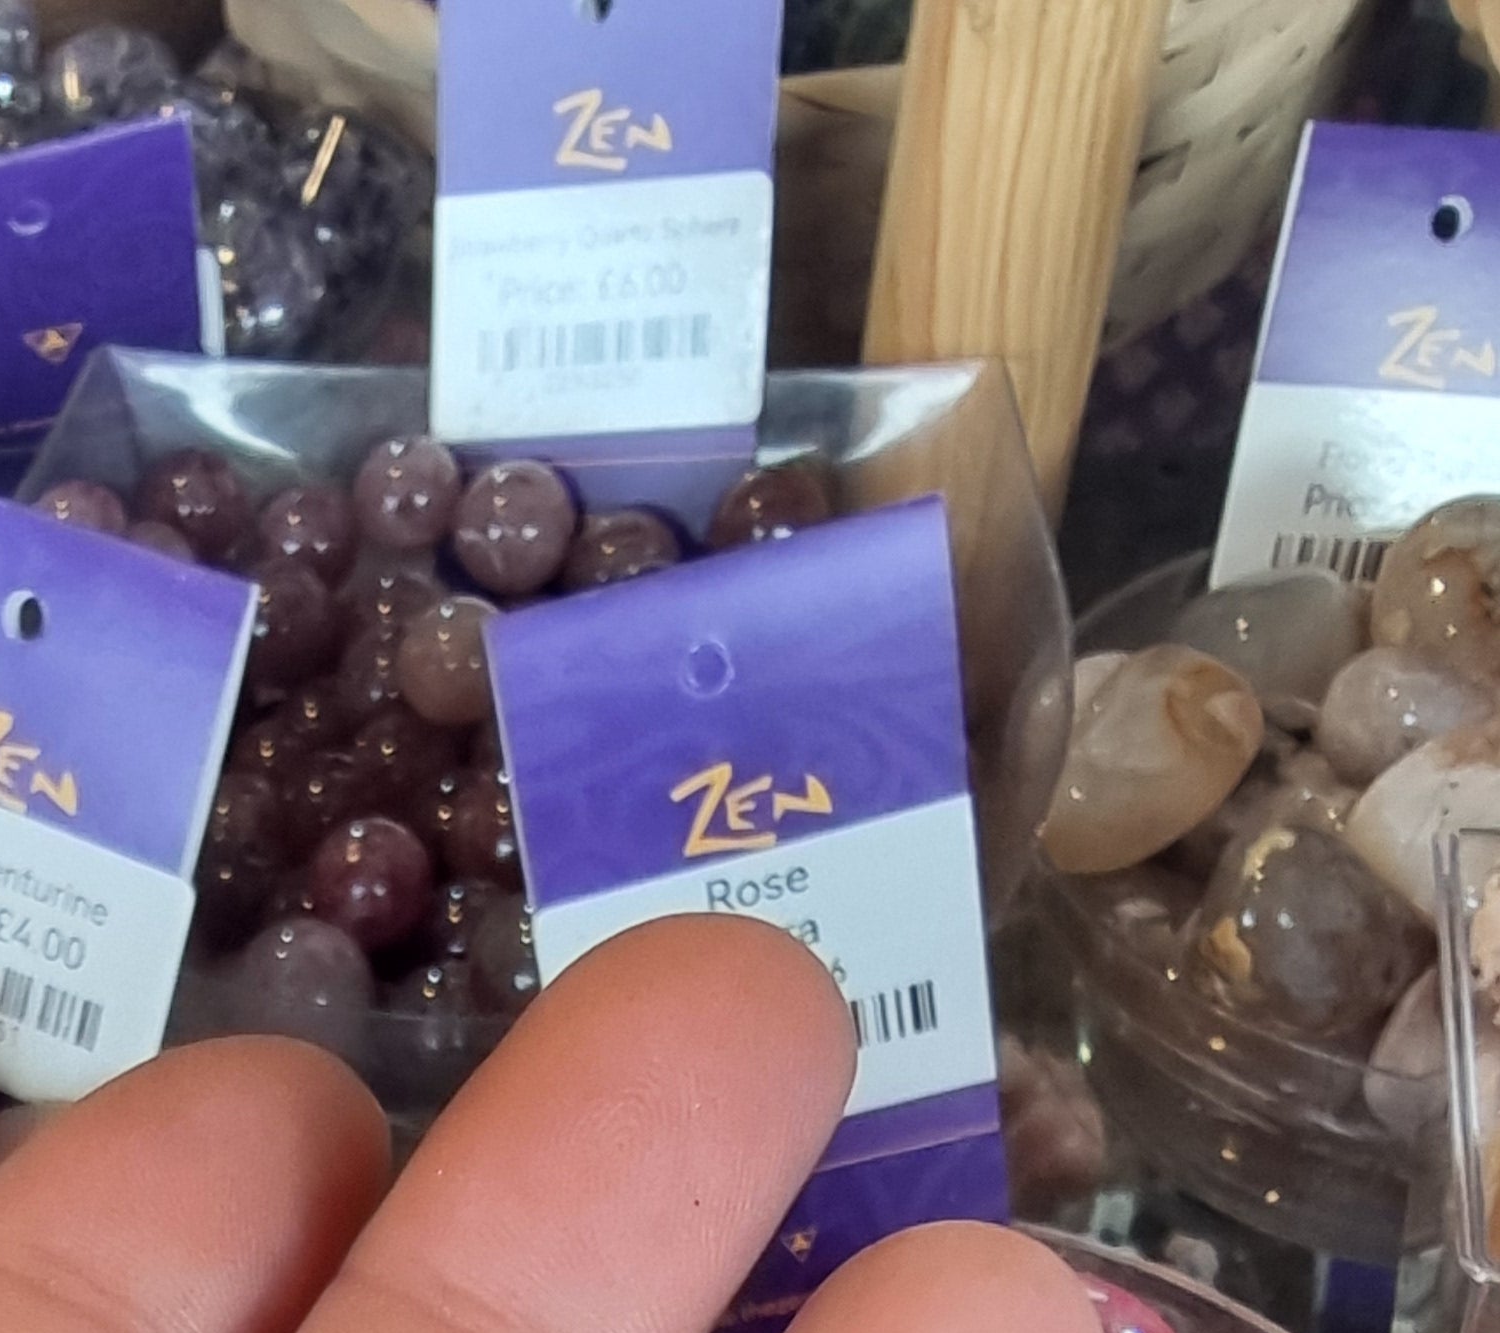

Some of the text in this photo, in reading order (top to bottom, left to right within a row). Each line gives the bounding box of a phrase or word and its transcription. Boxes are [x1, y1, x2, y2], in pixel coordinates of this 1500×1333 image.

[553, 88, 673, 172] ZEN
[1379, 305, 1497, 389] ZEN
[670, 761, 832, 857] ZEN
[706, 863, 810, 912] Rose
